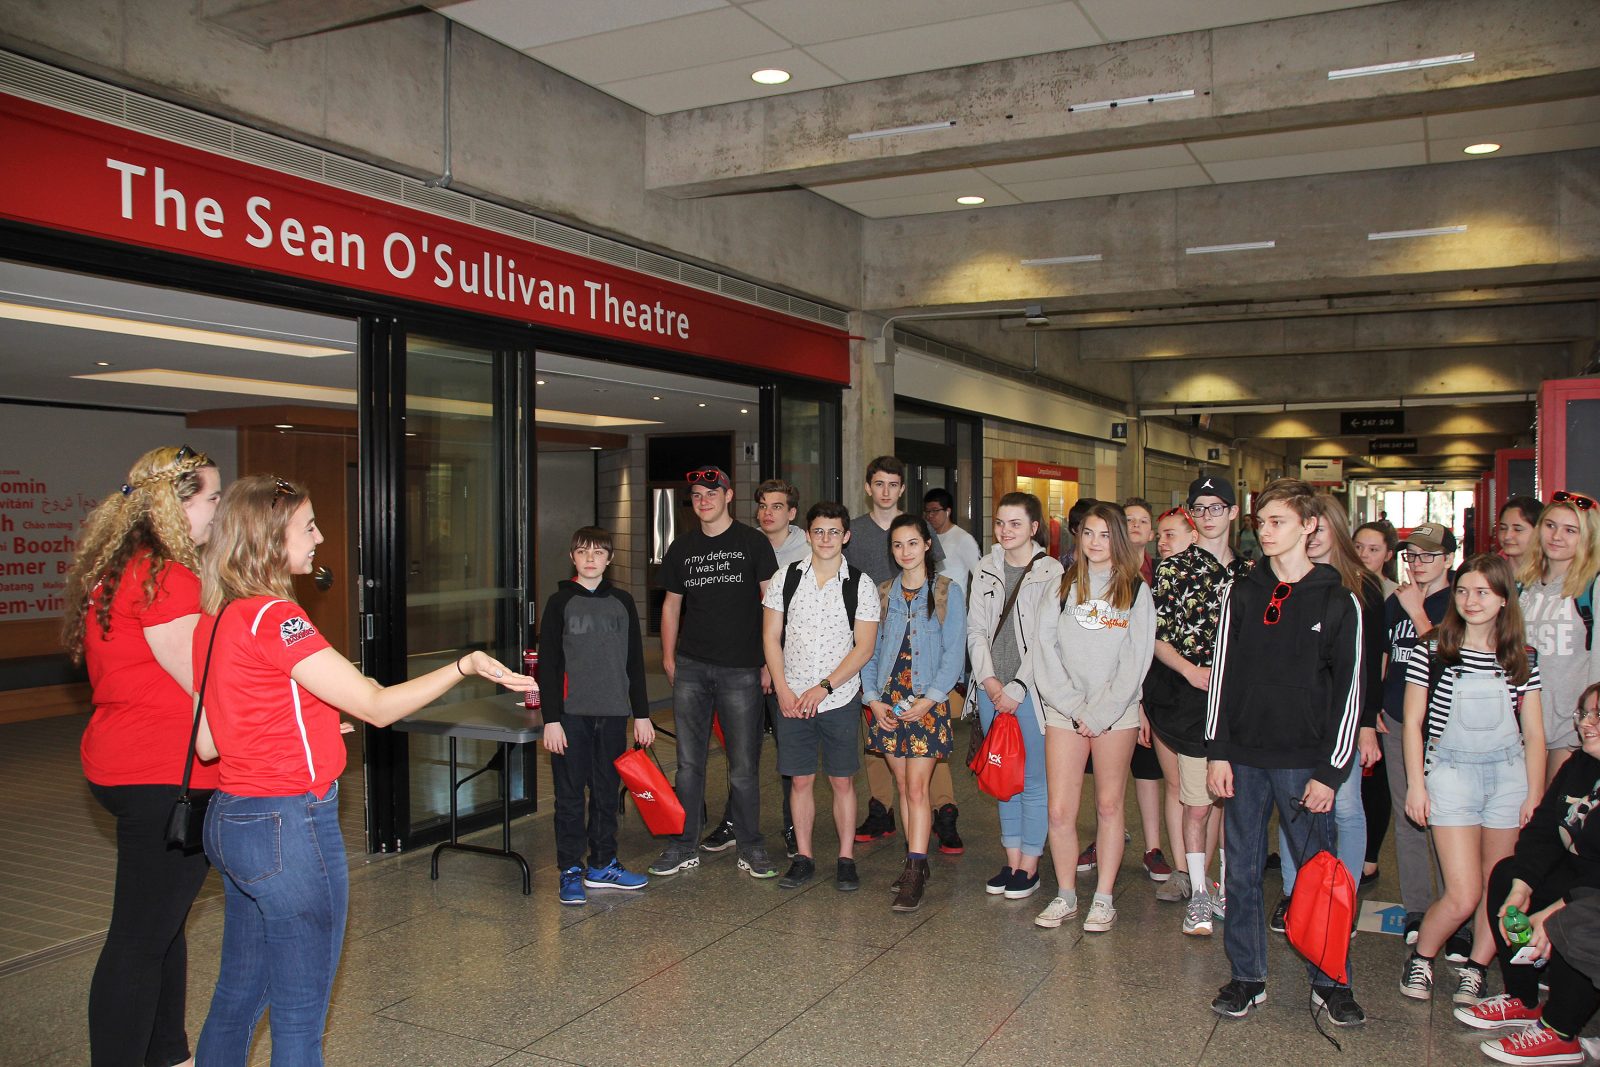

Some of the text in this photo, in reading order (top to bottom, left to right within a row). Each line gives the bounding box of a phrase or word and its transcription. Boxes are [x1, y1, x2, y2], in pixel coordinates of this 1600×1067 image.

[106, 158, 691, 340] The Sean O'Sullivan Theatre
[691, 555, 706, 564] my
[706, 550, 745, 561] defense,
[695, 564, 715, 573] was
[716, 561, 730, 571] left
[684, 572, 744, 587] nsupervised.
[1099, 616, 1129, 629] Softball
